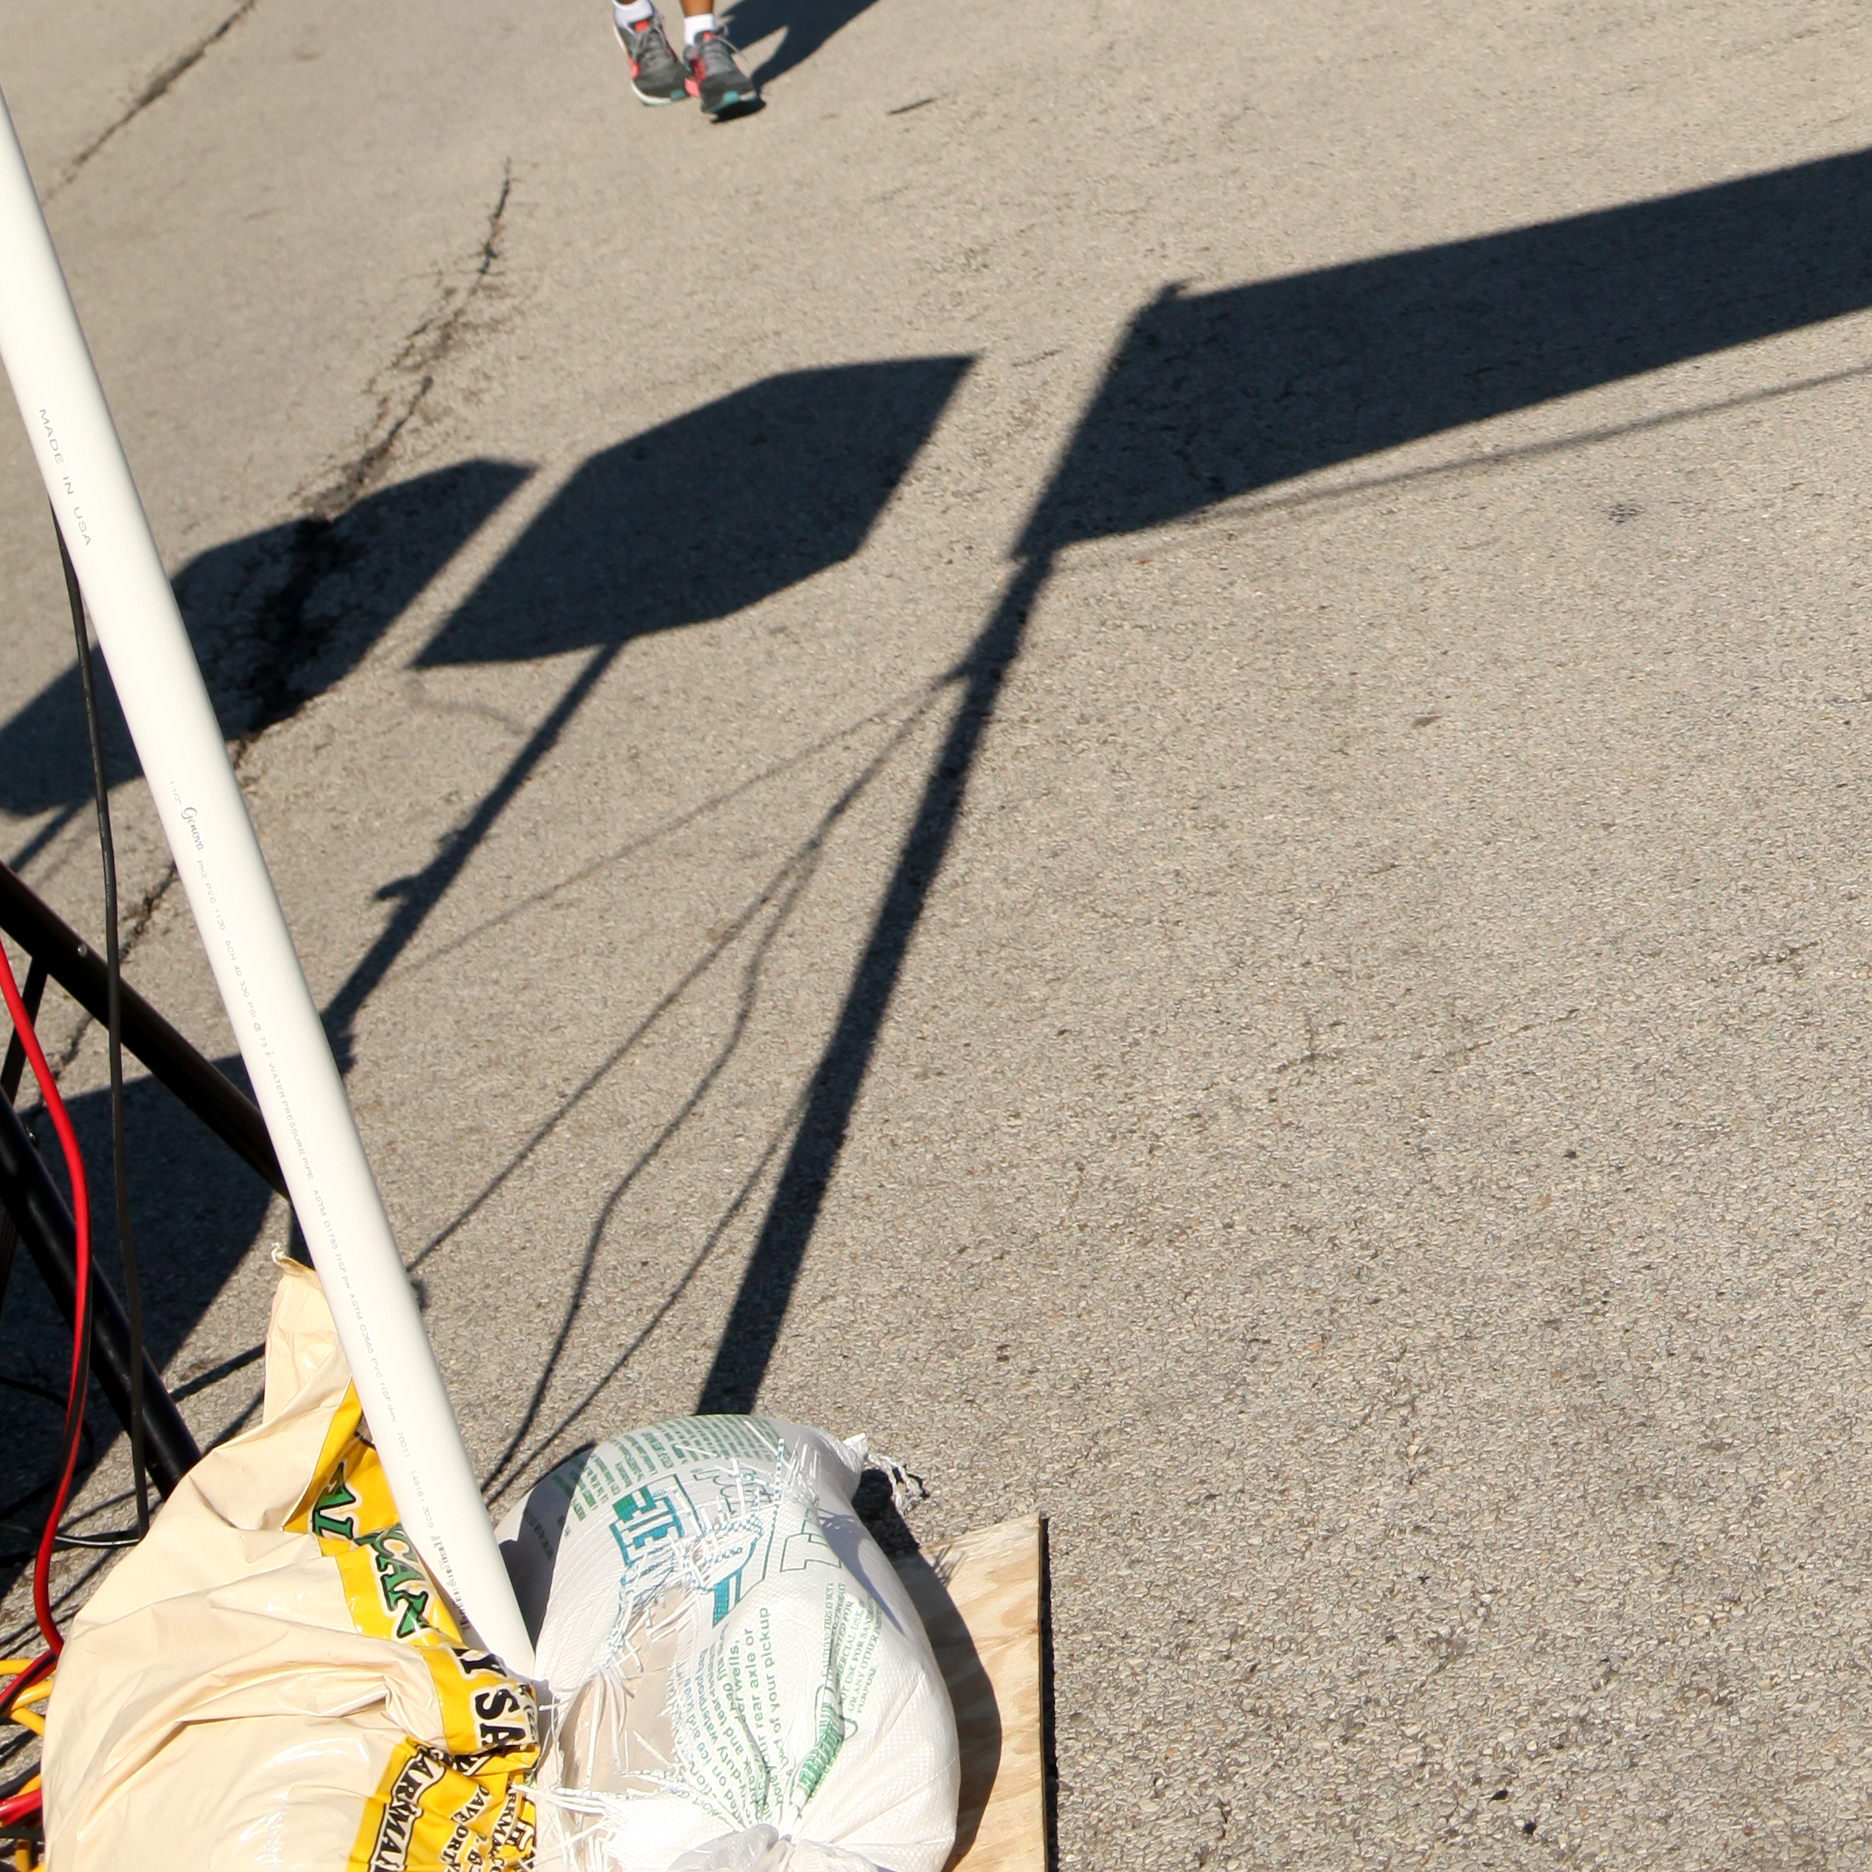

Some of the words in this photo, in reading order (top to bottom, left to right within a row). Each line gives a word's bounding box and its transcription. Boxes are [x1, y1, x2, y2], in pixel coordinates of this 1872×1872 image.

[38, 408, 64, 464] MADE
[62, 476, 74, 495] IN
[72, 506, 92, 546] USA
[759, 1607, 776, 1668] pickup
[746, 1652, 760, 1690] axle
